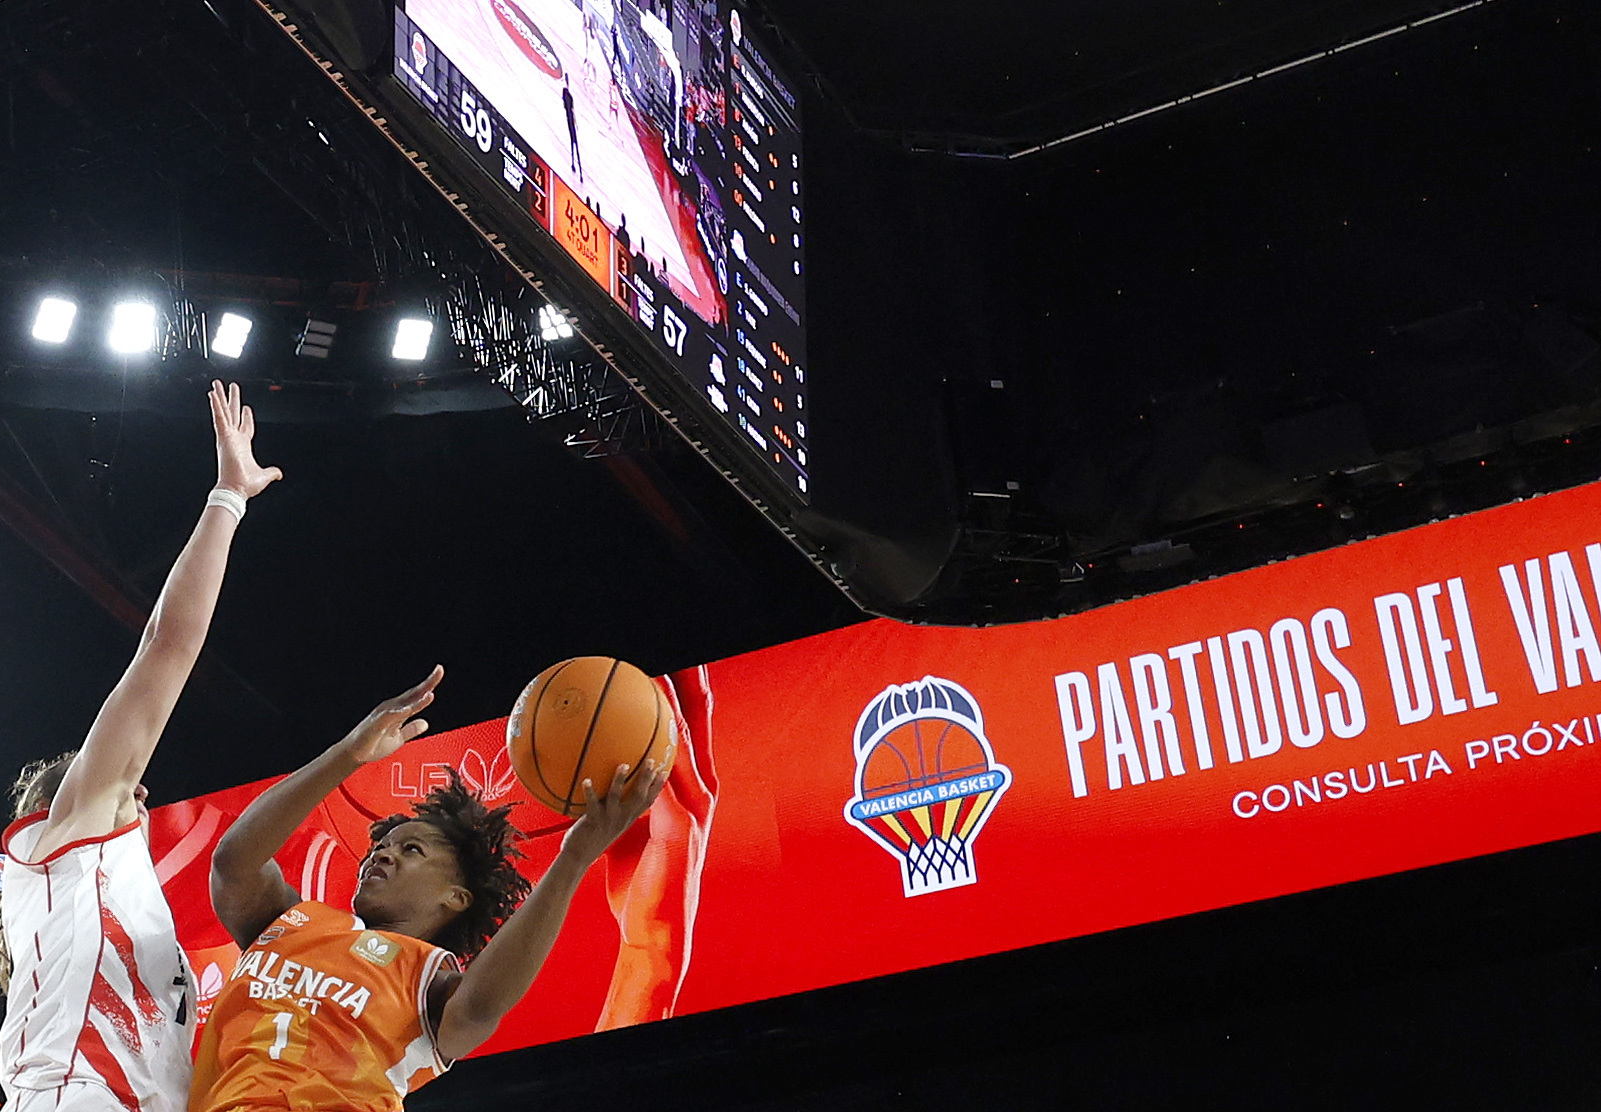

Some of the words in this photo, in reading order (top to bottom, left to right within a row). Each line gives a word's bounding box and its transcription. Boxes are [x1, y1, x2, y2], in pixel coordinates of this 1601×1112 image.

[461, 90, 492, 152] 59
[534, 166, 542, 186] 4
[534, 192, 542, 212] 2
[565, 199, 599, 253] 4:01
[621, 256, 628, 275] 3
[621, 283, 627, 299] 1
[663, 304, 687, 357] 57
[1053, 606, 1367, 799] PARTIDOS
[1373, 577, 1498, 726] DEL
[1232, 749, 1452, 819] CONSULTA
[1465, 714, 1601, 770] PRÓXI
[860, 790, 934, 816] VALENCIA
[938, 775, 995, 799] BASKET
[230, 951, 372, 1019] VALENCIA
[268, 1012, 294, 1060] 1
